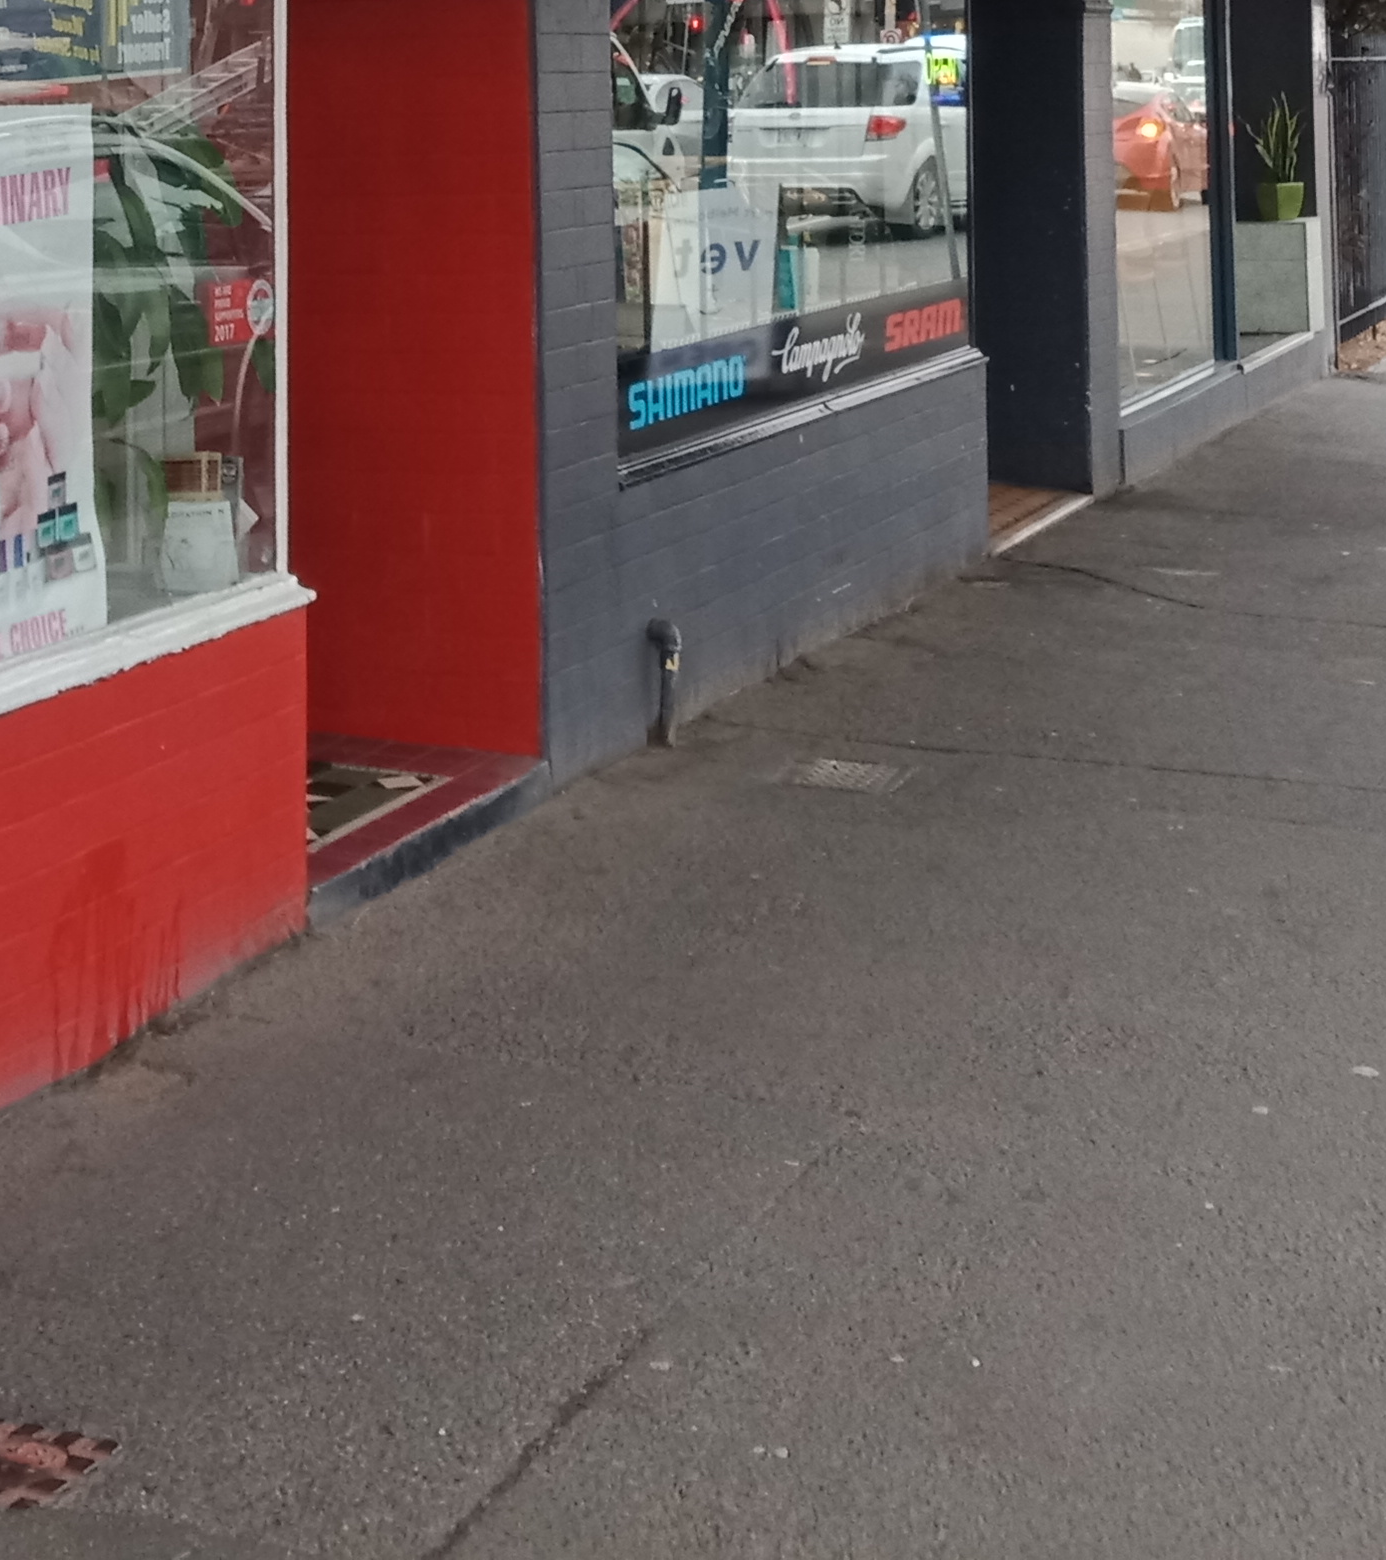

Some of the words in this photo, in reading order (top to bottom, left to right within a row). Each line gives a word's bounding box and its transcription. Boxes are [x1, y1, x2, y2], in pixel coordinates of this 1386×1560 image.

[214, 323, 235, 342] 2017
[771, 312, 865, 382] Campagnolo
[884, 298, 964, 352] SRAM
[628, 354, 747, 430] SHIMANO
